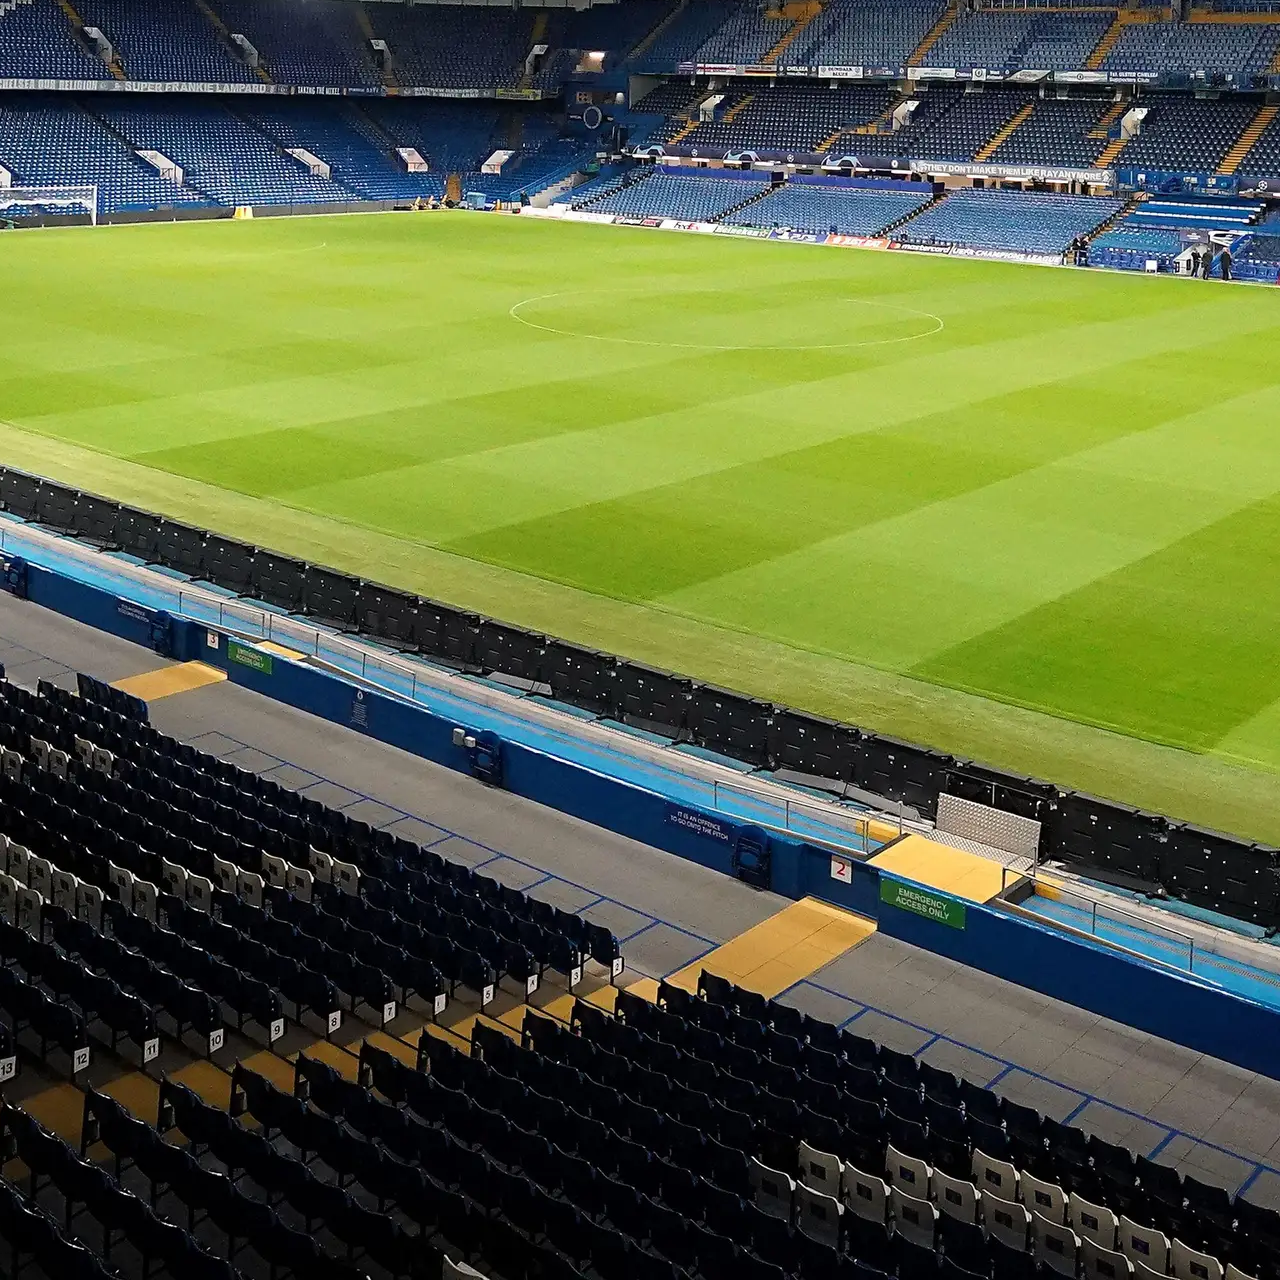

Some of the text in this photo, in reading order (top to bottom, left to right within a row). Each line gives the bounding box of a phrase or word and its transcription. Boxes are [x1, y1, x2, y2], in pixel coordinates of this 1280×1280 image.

[38, 80, 55, 90] OUR
[58, 80, 97, 91] RELIGION
[125, 81, 163, 91] SUPER
[164, 82, 214, 92] FRANKIE
[215, 83, 266, 94] LAMPARD
[928, 163, 947, 172] THEY
[972, 166, 996, 174] MAKE
[997, 167, 1020, 175] THEM
[1022, 167, 1039, 176] LIKE
[1041, 169, 1057, 177] RAY
[1057, 170, 1102, 179] ANYMORE
[901, 242, 950, 253] mastercard
[952, 247, 1062, 265] UEFA CHAMPIONS LEAGUE
[210, 633, 216, 643] 3
[670, 814, 678, 822] TO
[686, 820, 702, 831] ONTO
[702, 826, 712, 836] THE
[697, 818, 721, 831] OFFENCE
[836, 861, 846, 876] 2
[898, 887, 948, 911] EMERGENCY
[895, 894, 950, 921] ACCESS ONLY
[614, 963, 620, 972] 2
[574, 971, 579, 981] 3
[485, 989, 491, 999] 5
[387, 1006, 393, 1016] 7
[331, 1015, 337, 1026] 8
[274, 1024, 280, 1035] 9
[210, 1034, 221, 1046] 10
[147, 1043, 157, 1055] 11
[75, 1053, 87, 1065] 12
[0, 1062, 13, 1075] 13
